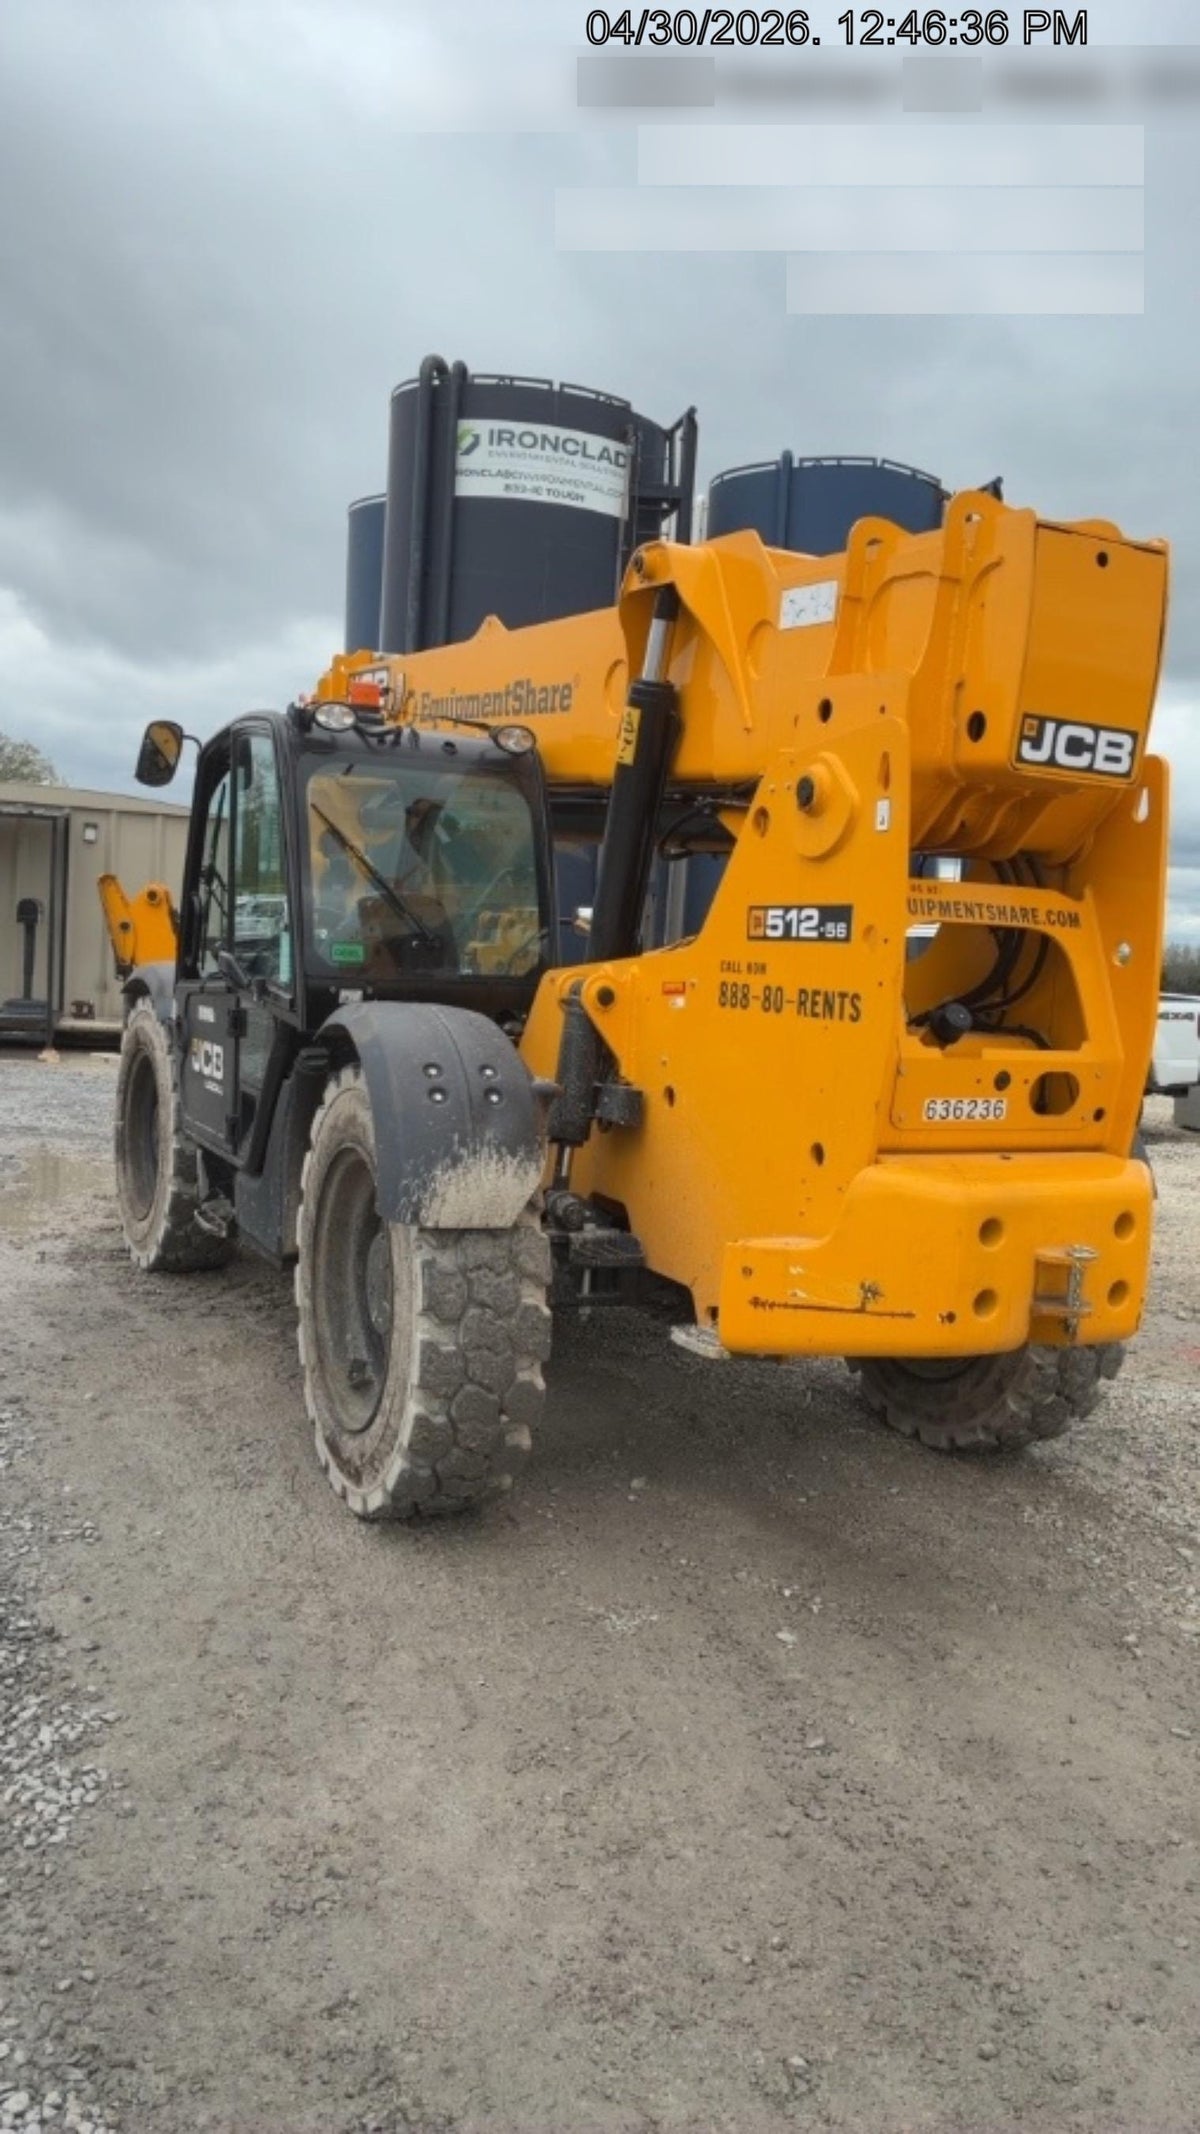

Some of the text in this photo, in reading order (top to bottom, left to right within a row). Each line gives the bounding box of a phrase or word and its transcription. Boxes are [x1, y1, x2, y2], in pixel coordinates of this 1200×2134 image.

[488, 428, 627, 468] IRONCLAD
[1021, 720, 1134, 775] JCB
[720, 960, 743, 974] CALL
[718, 980, 862, 1023] 888-80-RENTS
[925, 1099, 1005, 1120] 636236
